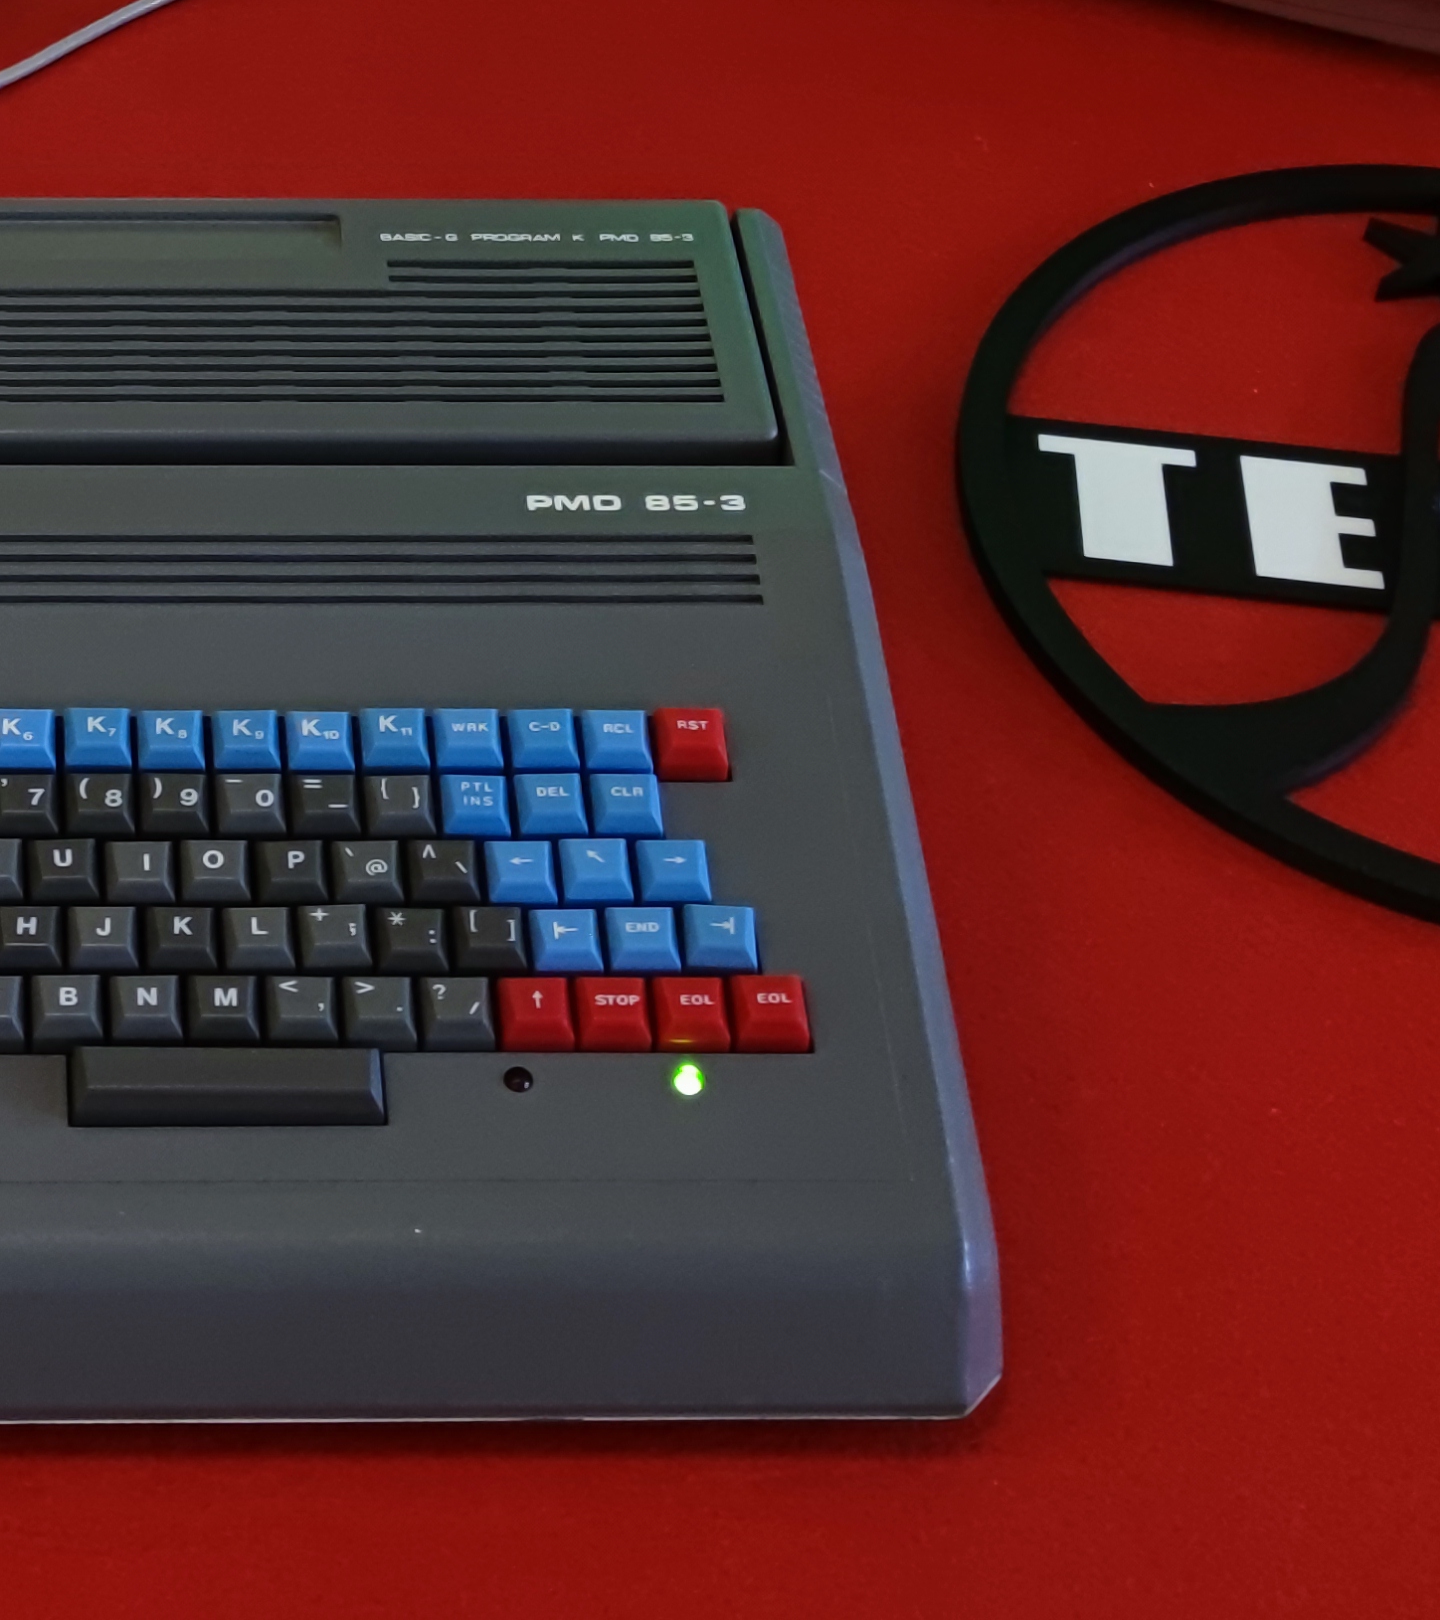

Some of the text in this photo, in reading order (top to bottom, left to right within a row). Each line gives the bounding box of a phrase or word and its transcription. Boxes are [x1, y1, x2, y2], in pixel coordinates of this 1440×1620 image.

[599, 234, 639, 242] PMD
[527, 495, 745, 510] PMD 85-3
[677, 720, 708, 730] RST
[461, 782, 492, 792] PTL
[536, 787, 568, 797] DEL
[611, 787, 643, 797] CLR
[28, 789, 45, 805] 7
[104, 789, 122, 807] 8
[180, 789, 198, 806] 9
[255, 789, 274, 807] 0
[463, 796, 493, 806] INS
[53, 849, 72, 866] U
[144, 854, 149, 870] I
[203, 850, 224, 868] O
[288, 851, 304, 868] P
[17, 917, 37, 935] H
[96, 918, 111, 936] J
[174, 917, 192, 935] K
[251, 917, 268, 934] L
[625, 922, 659, 932] END
[60, 987, 77, 1005] B
[137, 988, 157, 1005] N
[214, 988, 237, 1006] M
[595, 995, 640, 1005] STOP
[680, 995, 714, 1005] EOL
[757, 993, 791, 1003] EOL
